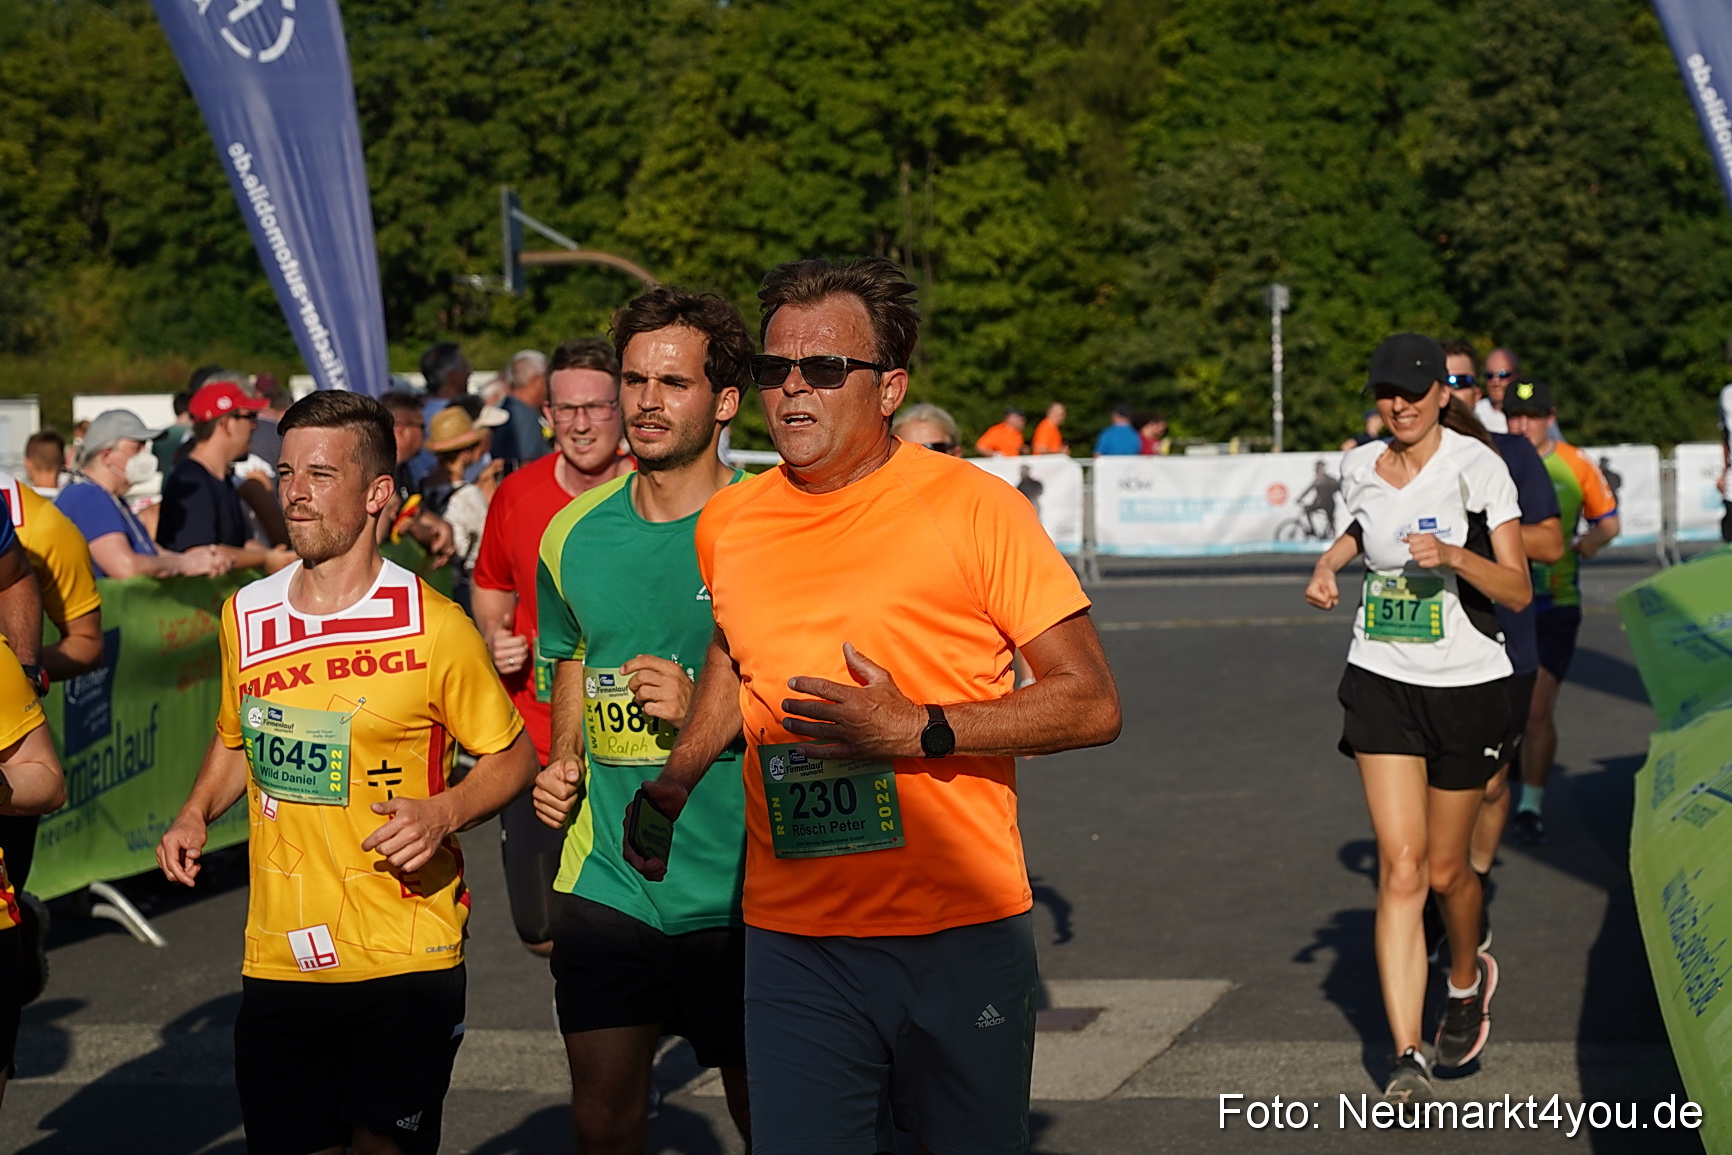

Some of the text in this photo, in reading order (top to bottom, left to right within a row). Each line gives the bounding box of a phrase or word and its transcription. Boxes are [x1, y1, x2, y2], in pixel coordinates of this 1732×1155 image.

[1382, 598, 1421, 621] 517
[239, 663, 315, 705] MAX
[326, 649, 427, 681] BÖGL
[263, 718, 295, 730] Firmenlauf
[586, 703, 598, 750] WALK
[254, 732, 328, 773] 1645
[607, 735, 648, 756] Ralph
[260, 766, 279, 780] Wild
[281, 772, 317, 786] Daniel
[330, 749, 343, 792] 2022
[785, 760, 824, 775] Firmenlauf
[800, 768, 825, 777] neumarkt
[788, 778, 858, 819] 230
[874, 778, 895, 832] 2022
[771, 797, 785, 835] RUN
[791, 819, 867, 836] Rösch Peter
[974, 1016, 1006, 1029] adidas
